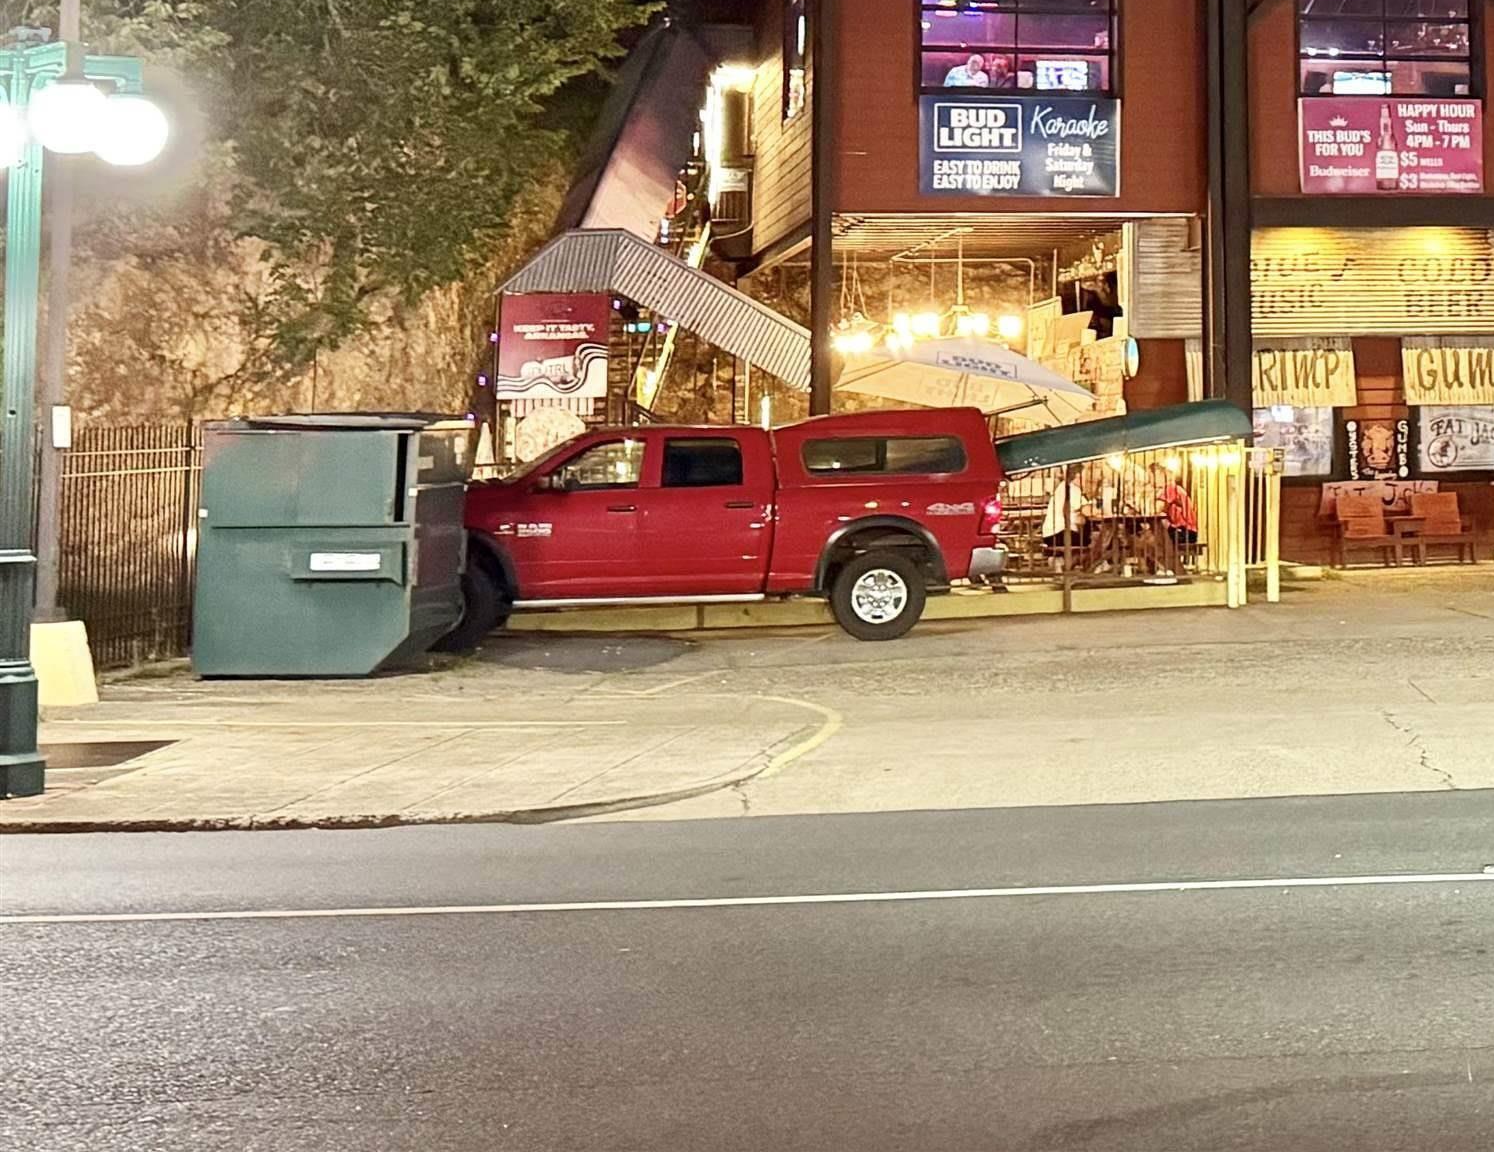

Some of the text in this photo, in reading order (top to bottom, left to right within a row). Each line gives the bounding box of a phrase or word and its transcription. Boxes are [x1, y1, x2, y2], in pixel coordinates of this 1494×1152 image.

[950, 109, 1006, 128] BUD
[1398, 104, 1475, 118] HAPPY HOUR
[1031, 104, 1109, 139] Karaoke
[1405, 120, 1428, 132] Sun
[1437, 120, 1470, 133] Thurs
[939, 127, 1017, 147] LIGHT
[1307, 130, 1371, 143] THIS BUD'S
[1406, 135, 1434, 148] 4PM
[1048, 143, 1092, 160] Friday &
[1315, 143, 1364, 156] FOR YOU
[933, 160, 1021, 174] EASY TO DRINK
[1045, 157, 1094, 175] Saturday
[1400, 151, 1418, 167] $5
[1309, 165, 1371, 177] Budweiser
[933, 175, 1020, 189] EASY TO ENJOY
[1054, 174, 1084, 192] Night
[1400, 172, 1418, 189] $3
[1398, 258, 1494, 282] COLD
[1251, 284, 1323, 317] USIC
[1404, 289, 1483, 317] BEER
[1256, 348, 1341, 391] RIMP
[1430, 418, 1466, 437] FAT
